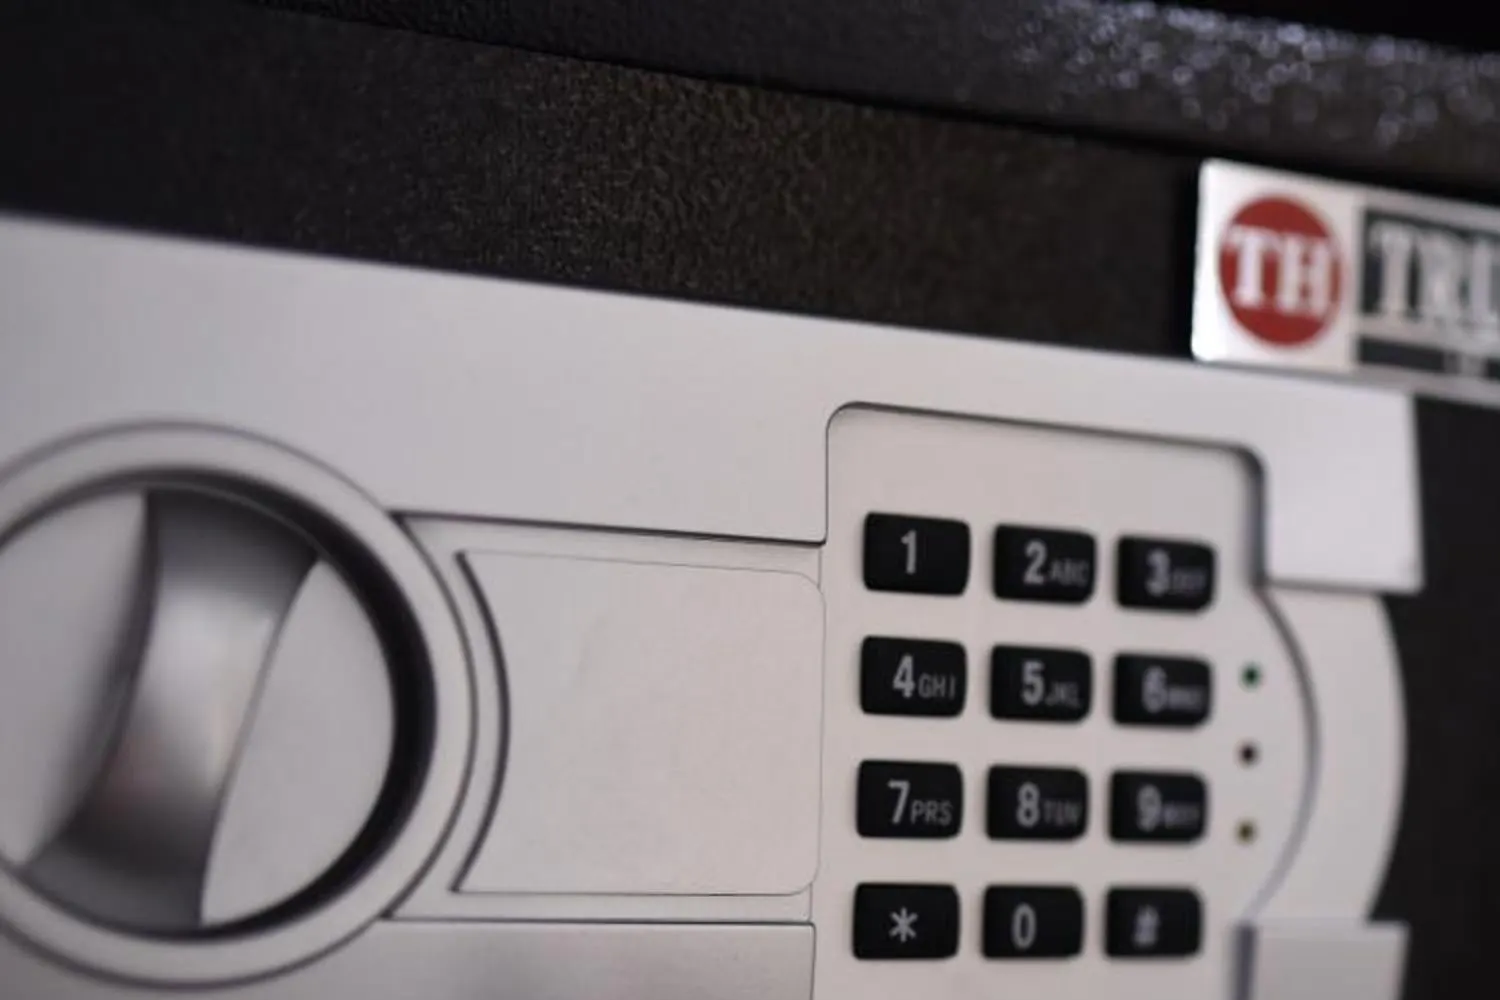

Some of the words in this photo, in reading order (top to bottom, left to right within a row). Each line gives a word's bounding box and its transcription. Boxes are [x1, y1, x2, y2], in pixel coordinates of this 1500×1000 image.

[1226, 224, 1333, 317] TH
[900, 529, 918, 575] 1
[1023, 540, 1047, 585] 2
[1145, 549, 1170, 597] 3
[892, 654, 916, 698] 4
[1021, 659, 1045, 706] 5
[1140, 666, 1167, 714] 6
[887, 779, 910, 824] 7
[910, 800, 954, 827] PRS
[1016, 782, 1040, 828] 8
[1136, 784, 1163, 833] 9
[1011, 902, 1036, 949] 0
